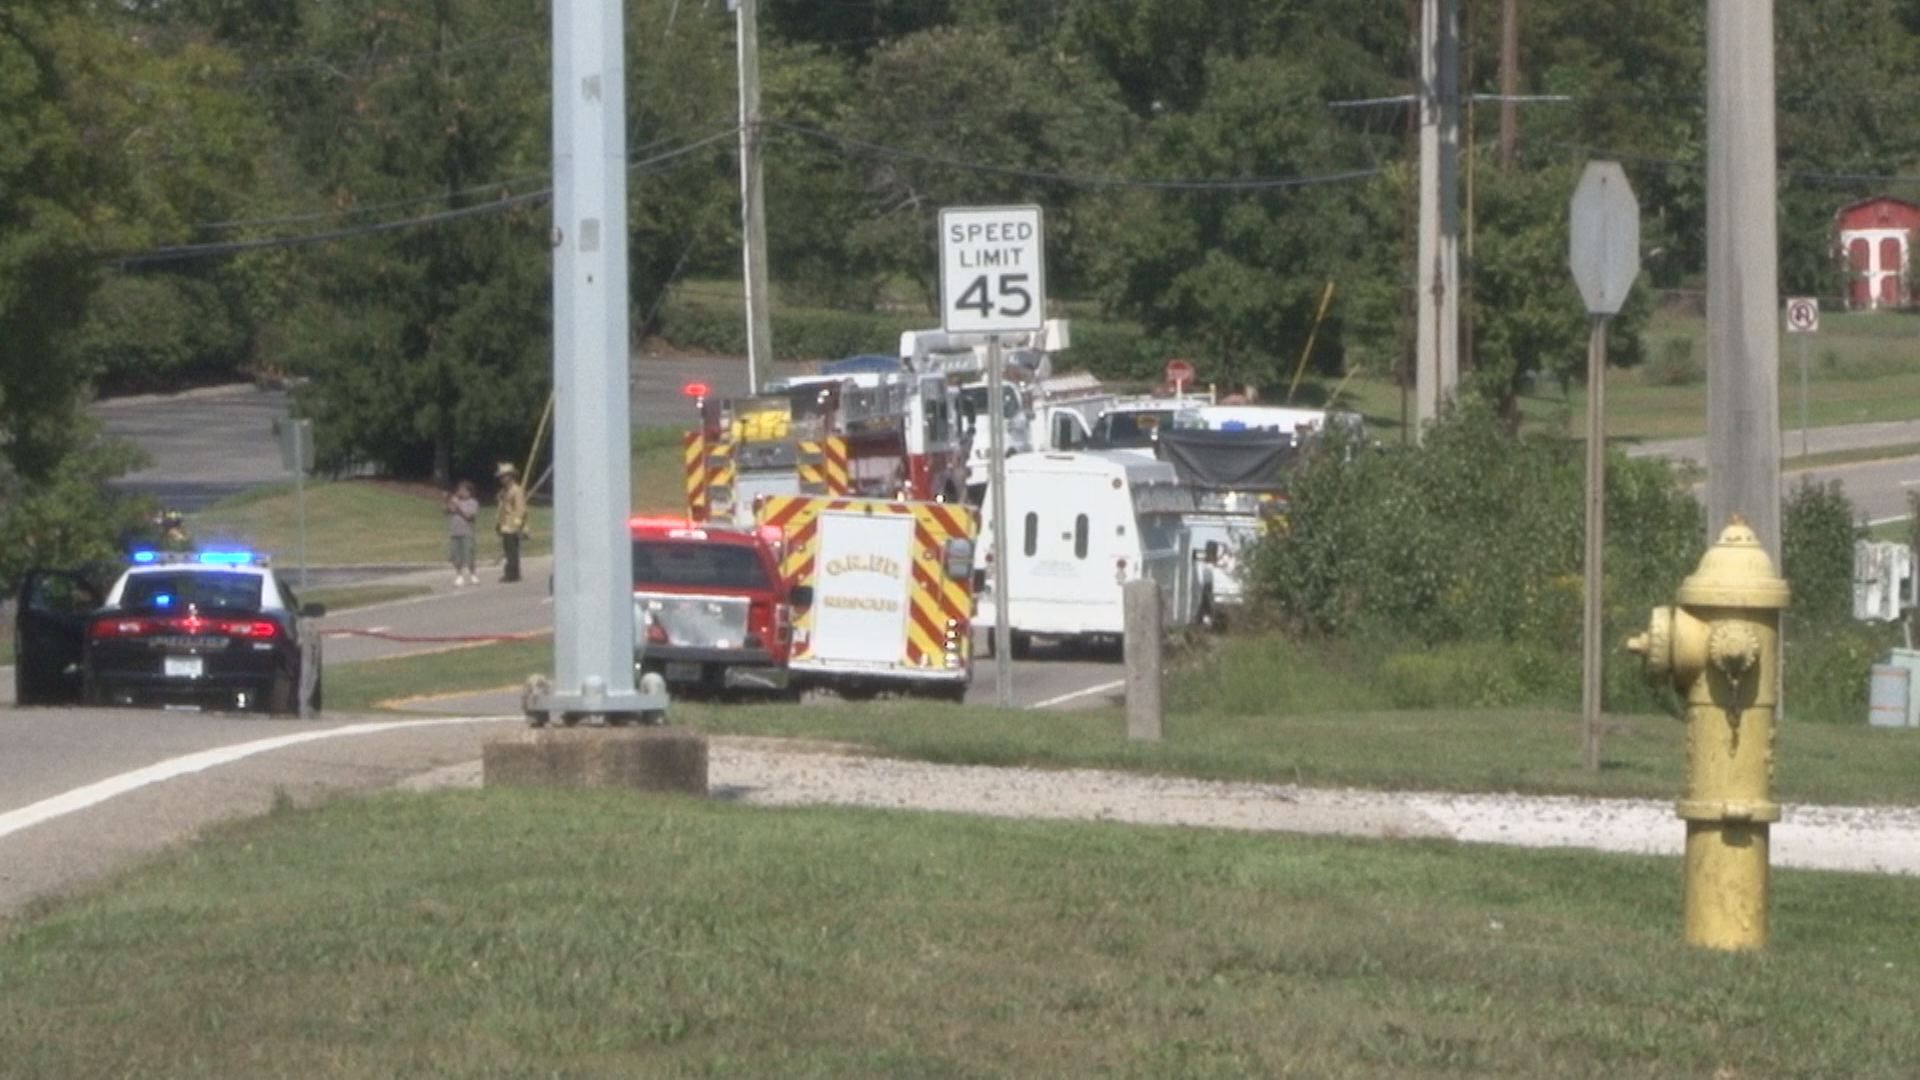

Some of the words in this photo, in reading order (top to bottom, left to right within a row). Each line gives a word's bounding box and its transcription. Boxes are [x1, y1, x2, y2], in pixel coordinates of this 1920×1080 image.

[950, 222, 1033, 243] SPEED
[960, 247, 1024, 268] LIMIT
[954, 273, 1033, 319] 45
